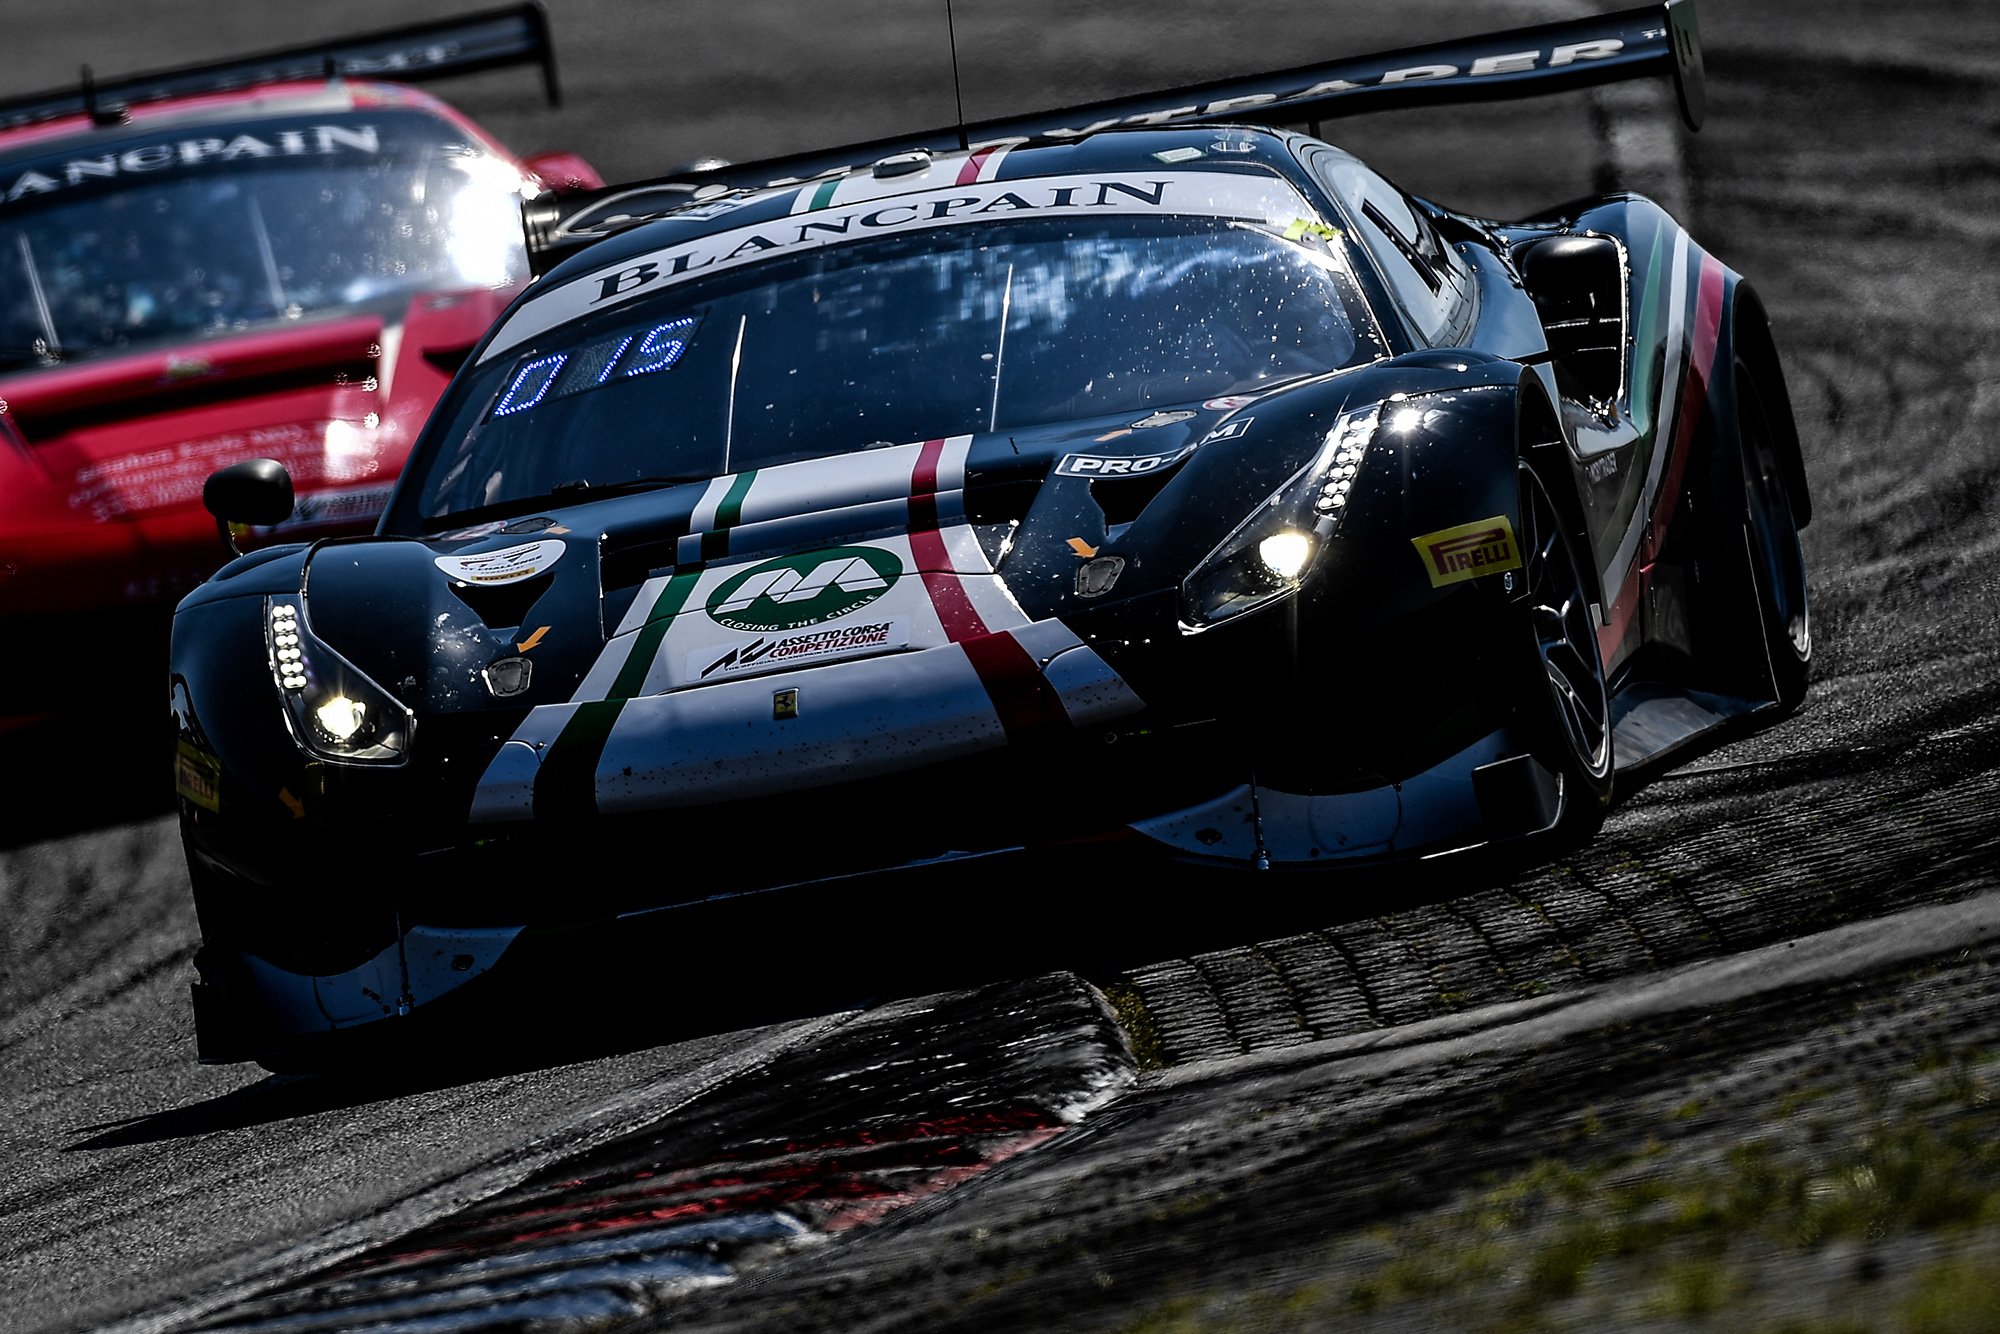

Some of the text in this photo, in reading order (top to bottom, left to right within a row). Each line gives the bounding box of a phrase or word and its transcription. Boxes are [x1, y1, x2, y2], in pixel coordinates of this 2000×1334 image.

[0, 124, 379, 204] ANCPAIN
[590, 181, 1174, 304] BLANCPAIN
[1428, 528, 1510, 576] PIRELLI
[720, 594, 879, 632] CLOSING THE CIRCLE
[769, 632, 889, 658] COMPETIZIONE
[778, 622, 890, 648] ASSETTO CORSA
